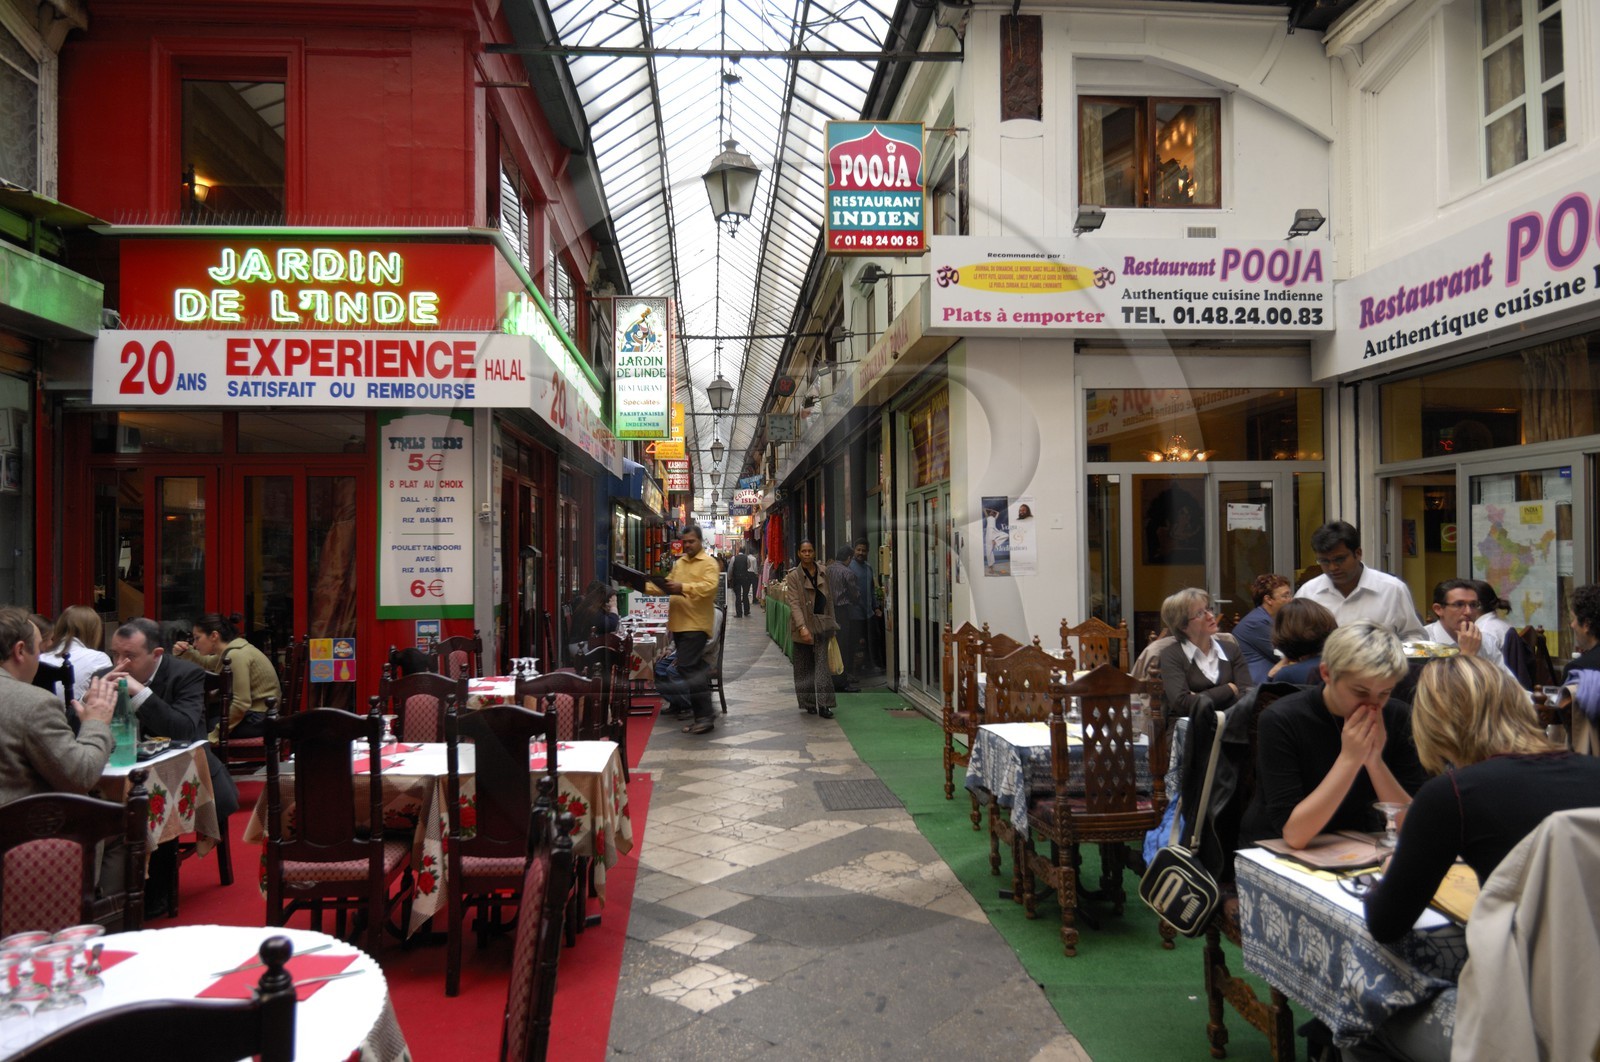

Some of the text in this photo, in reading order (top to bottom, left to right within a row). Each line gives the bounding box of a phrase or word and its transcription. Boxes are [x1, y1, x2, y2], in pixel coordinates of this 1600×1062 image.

[840, 154, 911, 187] POOJA
[833, 196, 921, 207] RESTAURANT
[832, 211, 920, 226] INDIEN
[845, 235, 918, 245] 01 48 24 00 83
[208, 248, 403, 284] JARDIN
[1122, 248, 1323, 287] Restaurant POOJA
[1359, 191, 1600, 330] Restaurant PO
[1121, 288, 1323, 302] Authentique cuisine Indienne
[174, 288, 243, 323] DE
[942, 307, 1105, 326] Plats à emporter
[1121, 307, 1323, 325] TEL. 01.48.24.00.83
[1363, 277, 1586, 359] Authentique cuisine
[119, 338, 477, 395] 20 ANS EXPERIENCE
[485, 359, 526, 381] HALAL
[618, 356, 663, 367] JARDIN
[617, 368, 631, 378] DE
[227, 381, 475, 399] SATISFAIT OU REMBOURSE
[407, 453, 445, 472] 5€
[389, 480, 464, 488] 8 PLAT AU CHOIX
[410, 579, 445, 598] 6€
